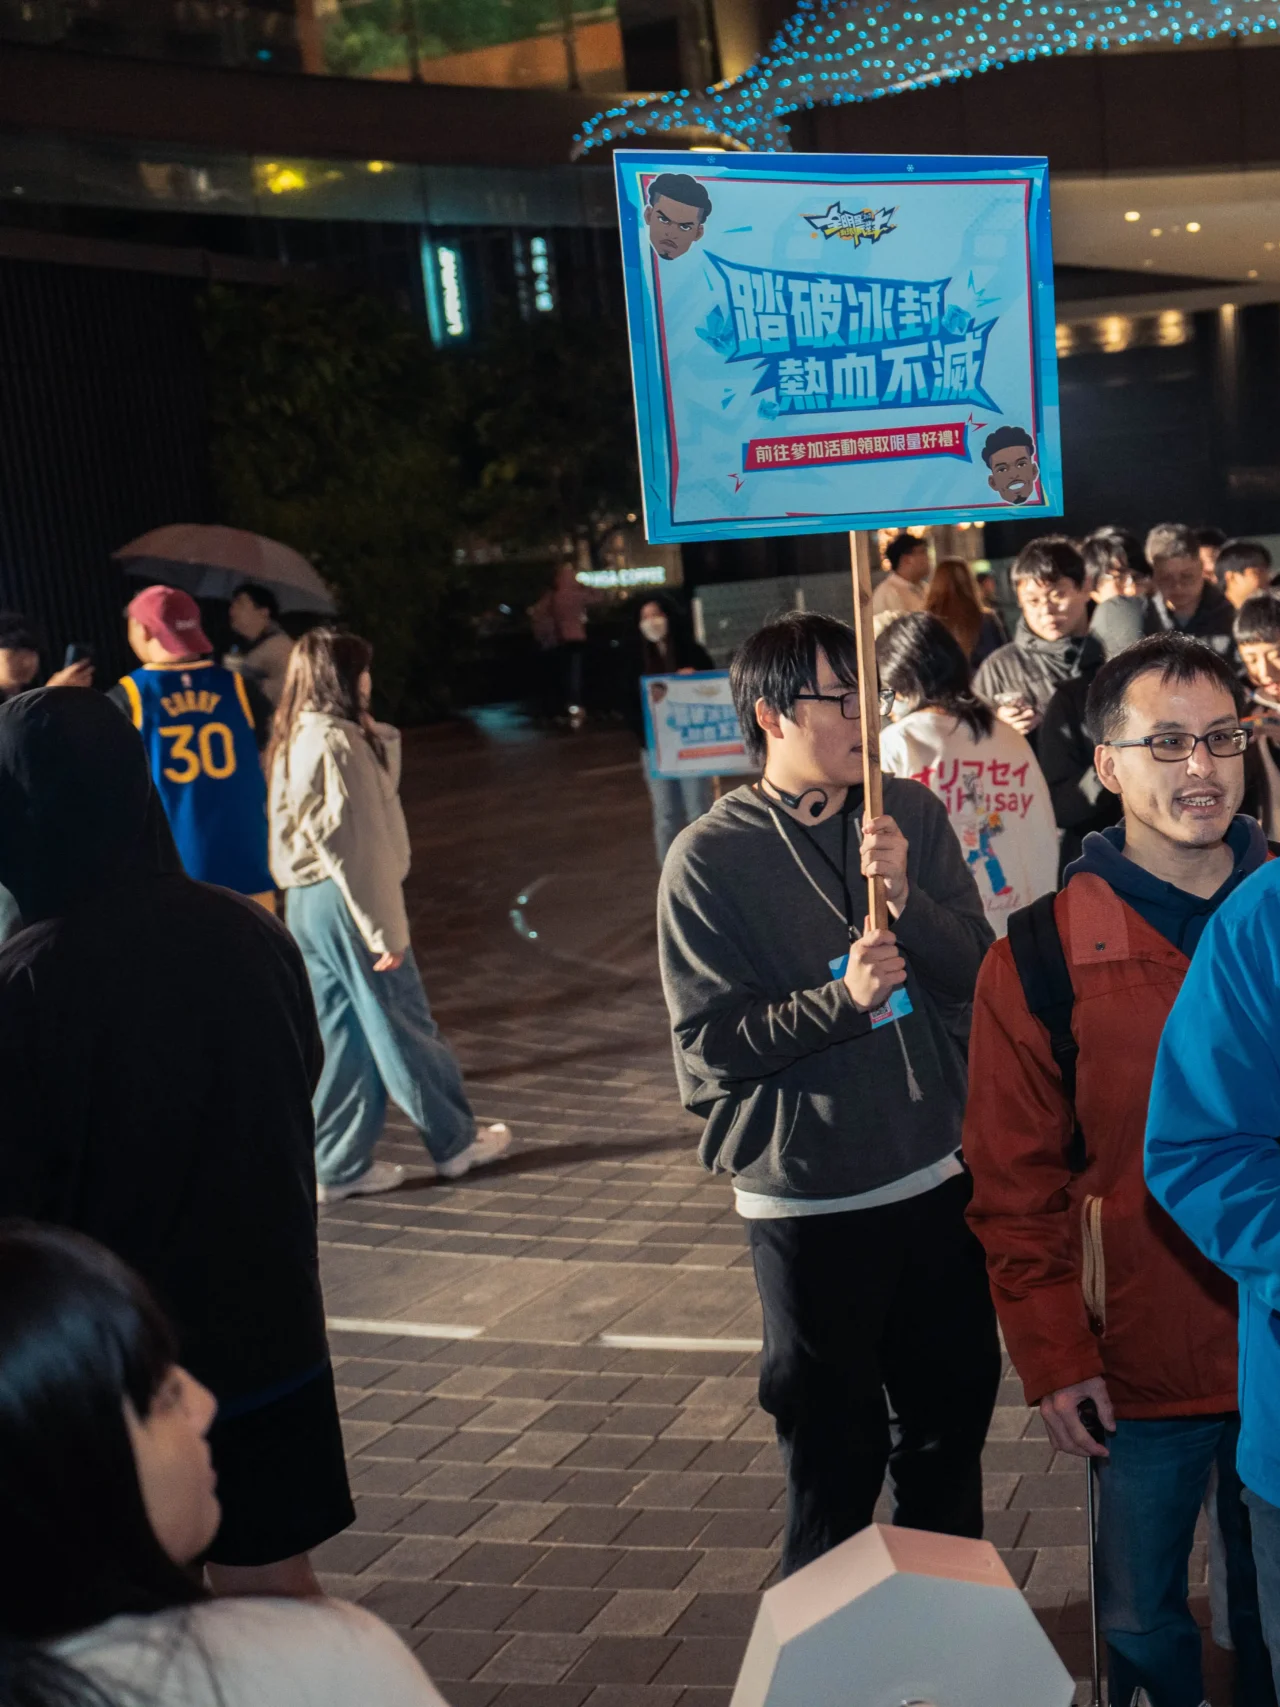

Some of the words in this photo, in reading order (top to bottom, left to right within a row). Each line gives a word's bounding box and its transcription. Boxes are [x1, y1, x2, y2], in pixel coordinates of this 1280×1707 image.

[733, 271, 942, 354] 踏破冰封
[777, 330, 992, 412] 熱血不滅
[755, 430, 960, 464] 前往參加活動領取限量好禮!
[160, 689, 222, 718] CURRY
[158, 721, 237, 784] 30
